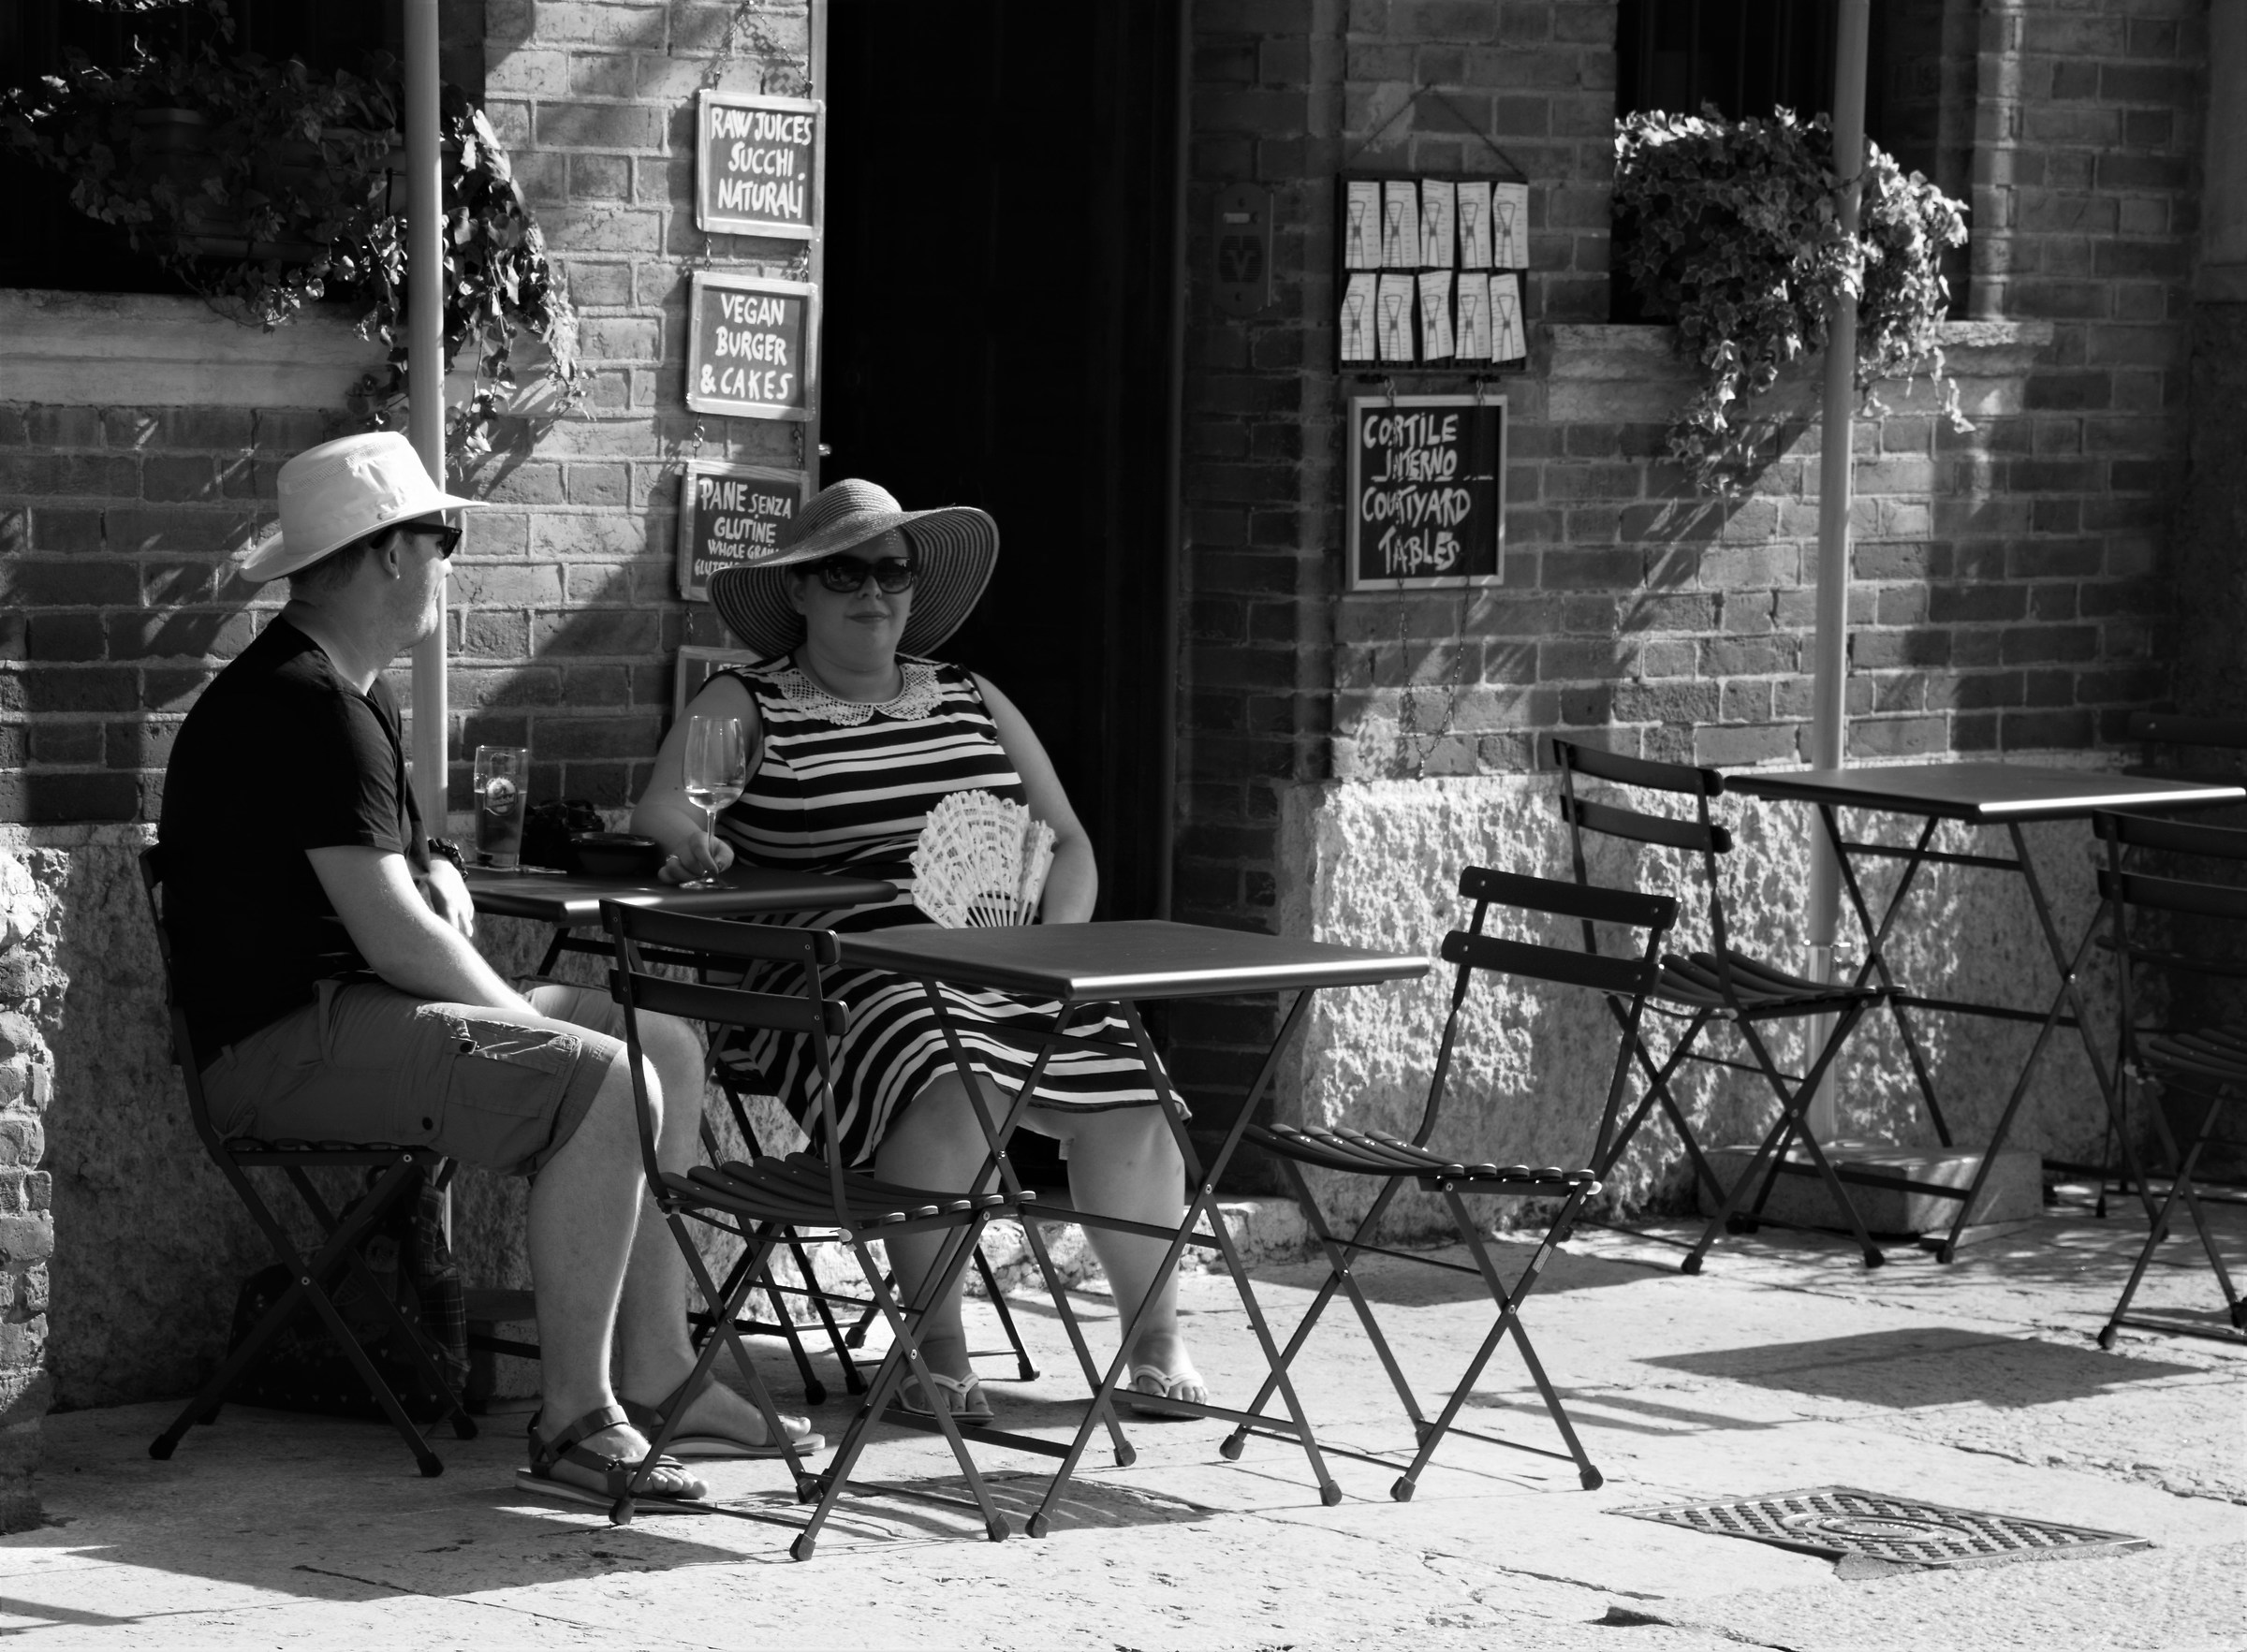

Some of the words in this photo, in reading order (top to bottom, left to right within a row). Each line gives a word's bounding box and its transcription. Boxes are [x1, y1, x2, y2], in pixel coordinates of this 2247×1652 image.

[712, 107, 754, 139] RAW
[755, 111, 814, 146] JUICES
[728, 141, 794, 177] SUCCHI
[718, 172, 806, 219] NATURALI
[720, 293, 786, 328] VEGAN
[714, 326, 787, 366] BURGER
[700, 363, 717, 394] &
[720, 367, 794, 401] CAKES
[1363, 412, 1459, 448] CORTILE
[698, 477, 749, 512] PANE
[748, 493, 792, 519] SENZA
[1362, 485, 1471, 528] COURTYARD
[713, 514, 777, 544] GLUTINE
[707, 539, 745, 559] WHOLE
[1378, 525, 1461, 575] TABLES
